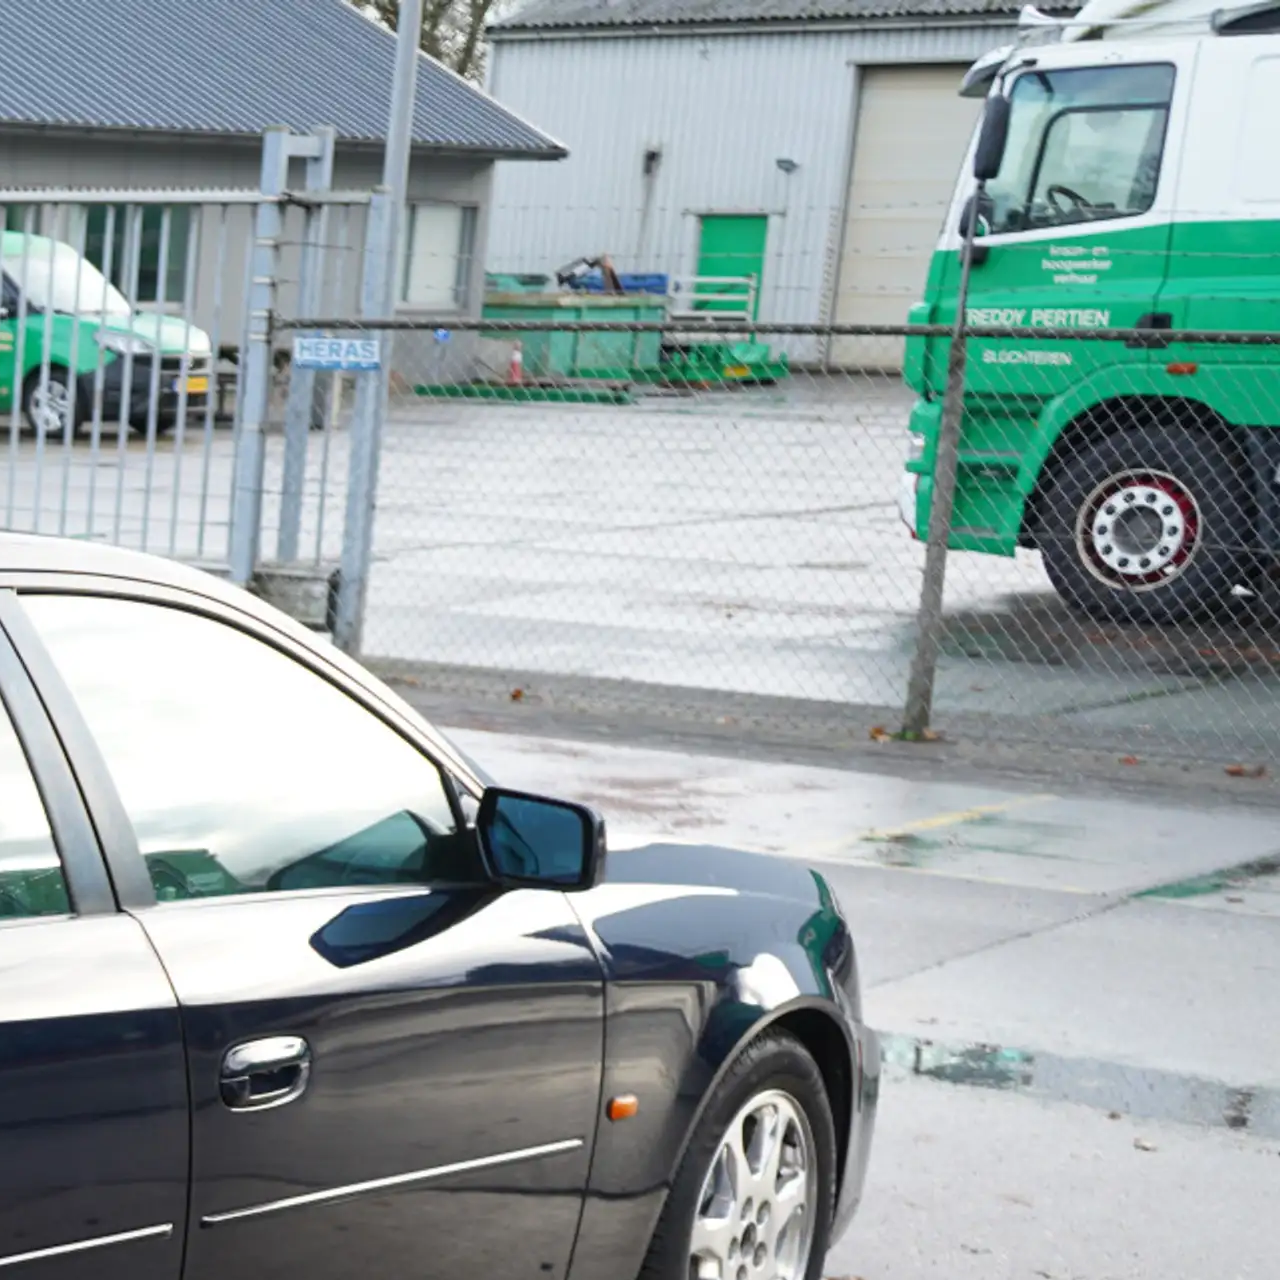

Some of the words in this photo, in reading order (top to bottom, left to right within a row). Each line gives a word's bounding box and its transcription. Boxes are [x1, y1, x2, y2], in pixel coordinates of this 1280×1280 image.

[965, 308, 1027, 328] REDDY
[1031, 308, 1110, 328] PERTIEN
[299, 341, 375, 359] HERAS
